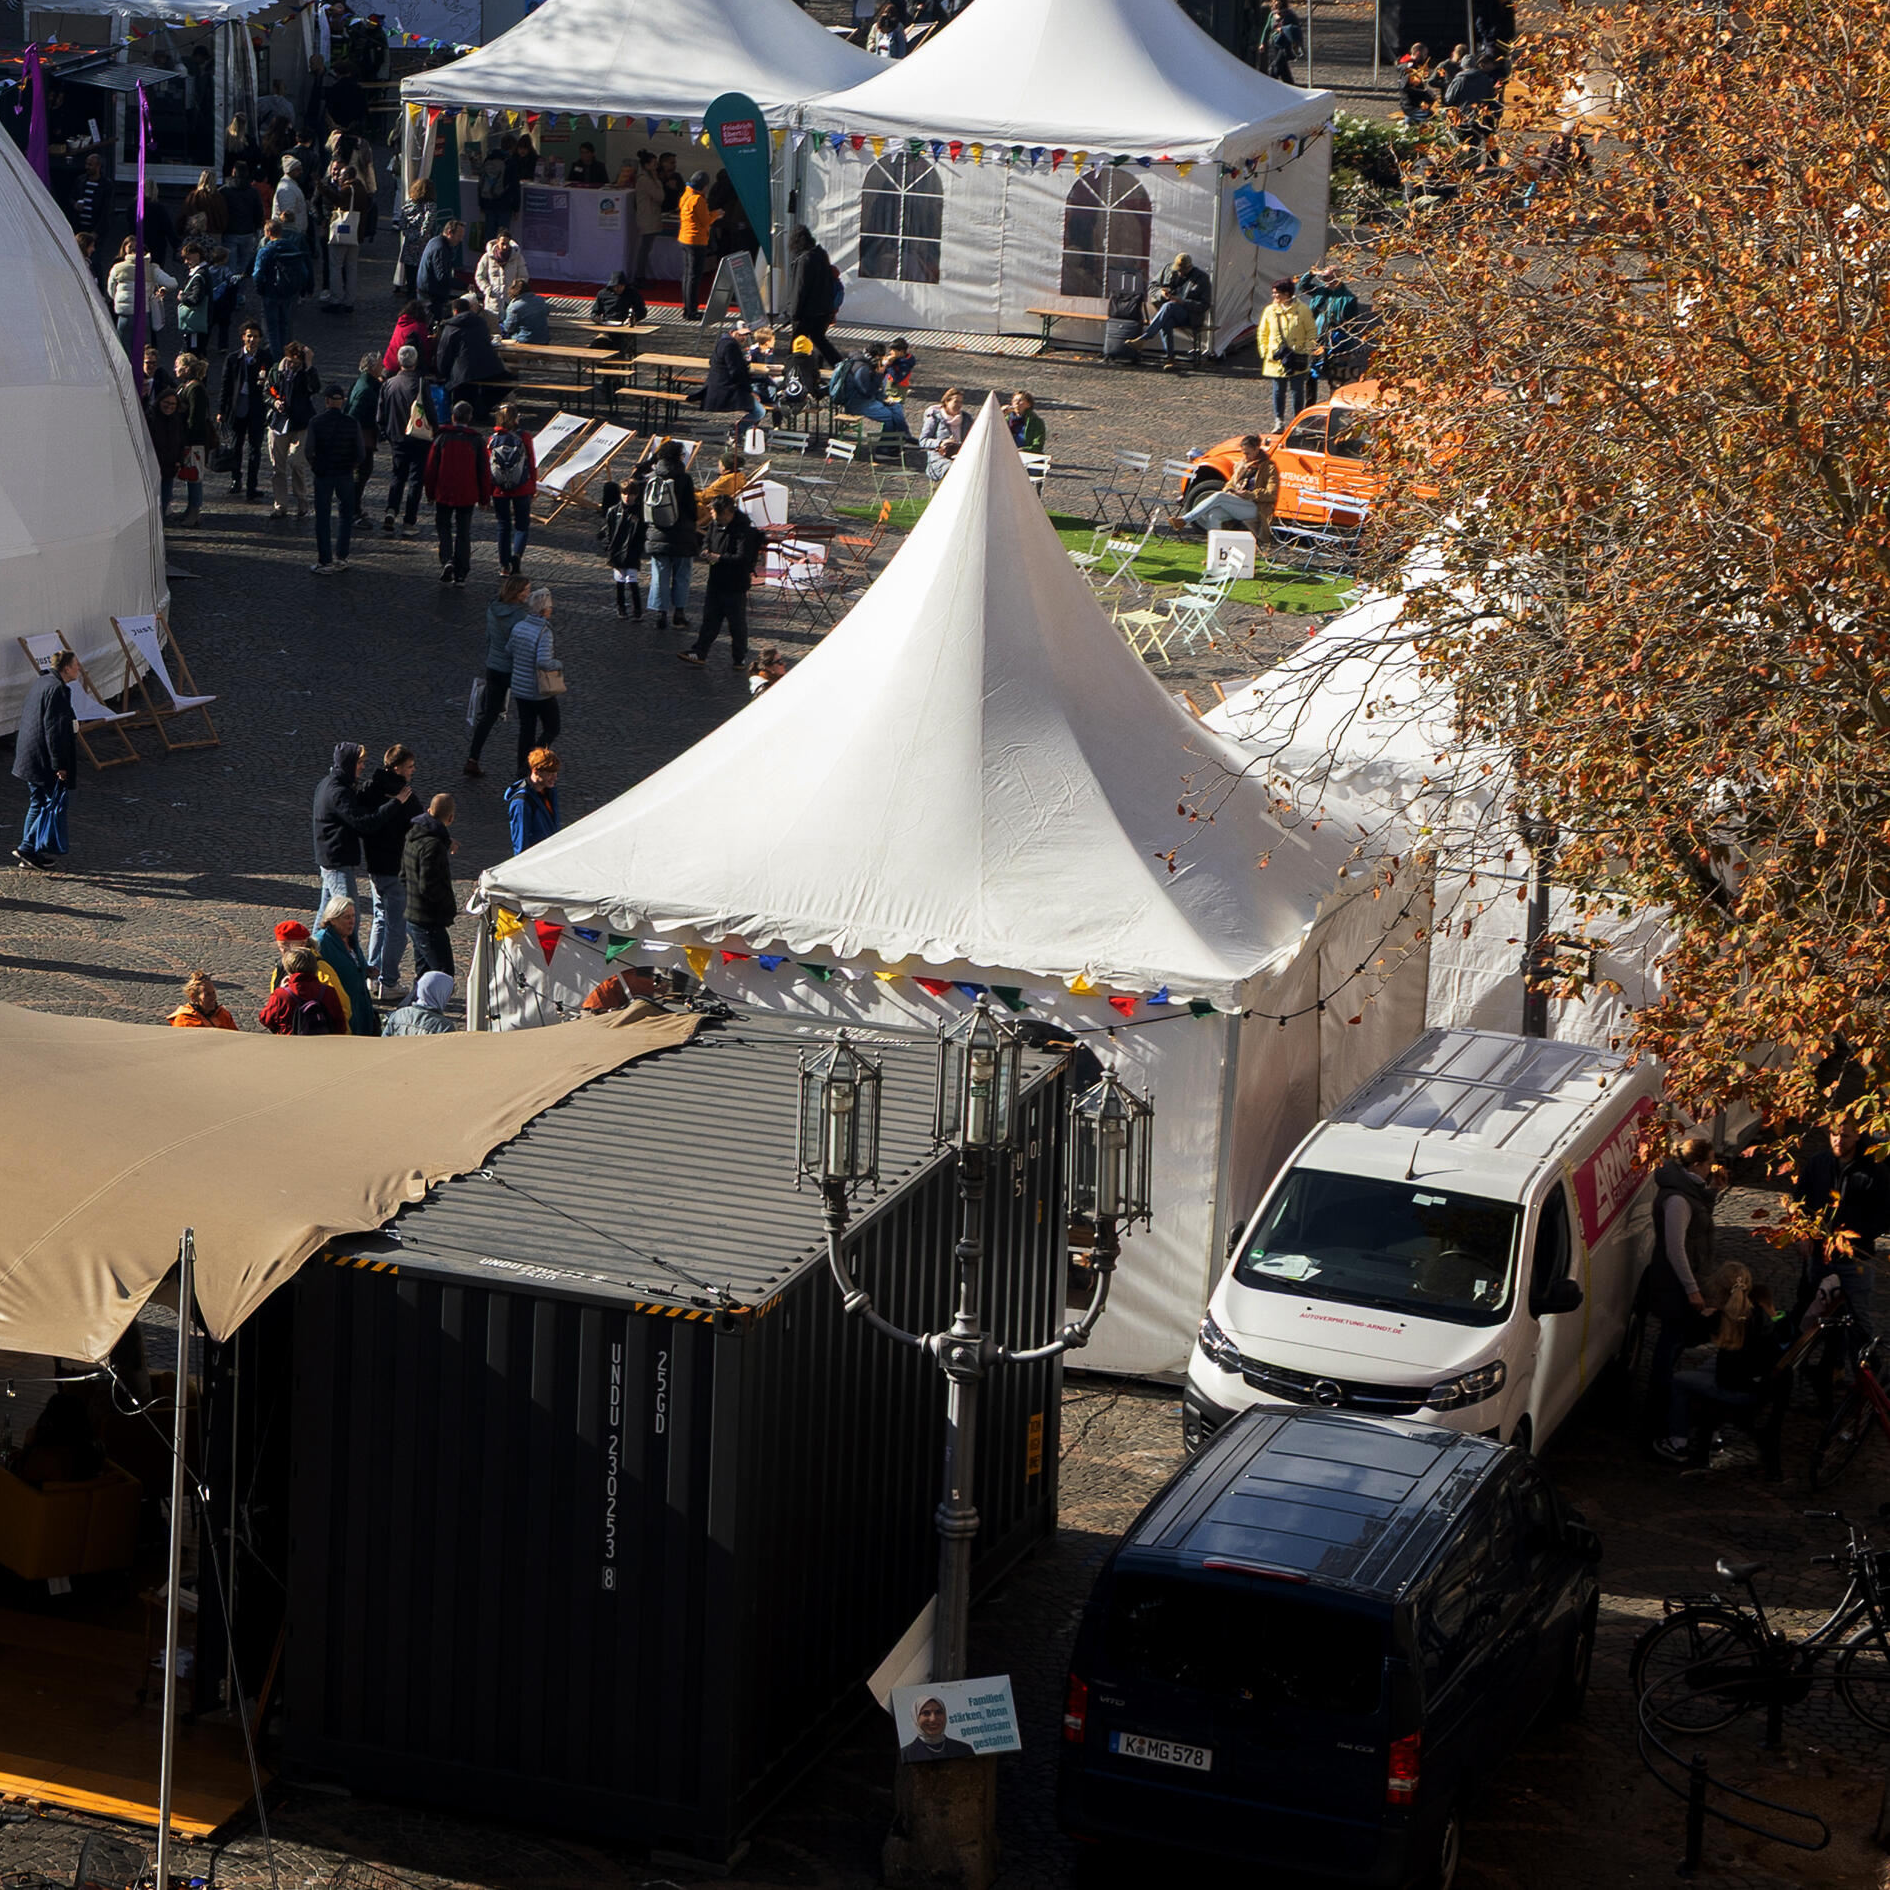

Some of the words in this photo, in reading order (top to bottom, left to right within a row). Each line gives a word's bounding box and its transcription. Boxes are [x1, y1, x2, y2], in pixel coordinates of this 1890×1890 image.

[478, 1258, 524, 1271] UNDU
[1300, 1313, 1405, 1335] AUTOVERMIETUNG-ARNDT.DE
[609, 1343, 623, 1427] UNDU
[654, 1351, 669, 1434] 25GD
[605, 1434, 620, 1560] 230253
[604, 1568, 615, 1589] 8
[968, 1692, 1005, 1707] Familien
[1099, 1694, 1126, 1708] VITO
[948, 1709, 985, 1724] stärken,
[986, 1707, 1008, 1720] Bonn
[961, 1721, 1011, 1737] gemeinsam
[973, 1734, 1014, 1751] gestalten
[1125, 1736, 1134, 1753] K
[1147, 1739, 1169, 1759] MG
[1173, 1744, 1204, 1766] 578
